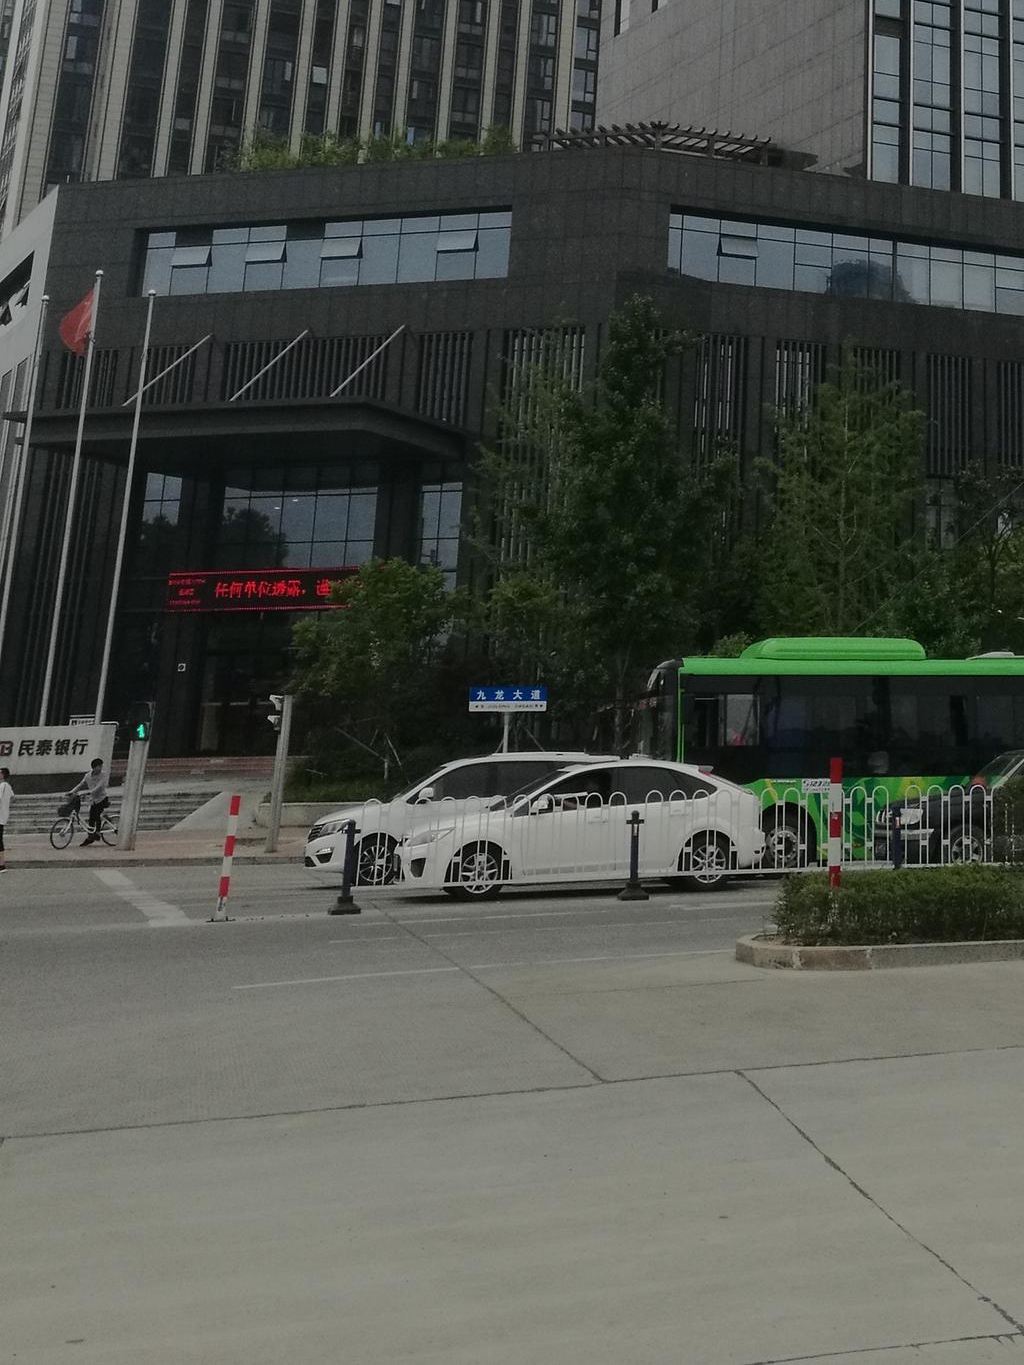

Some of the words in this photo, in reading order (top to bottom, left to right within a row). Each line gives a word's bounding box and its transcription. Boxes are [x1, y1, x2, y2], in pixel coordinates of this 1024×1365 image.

[476, 689, 542, 700] 九龙大道
[18, 739, 88, 756] 民泰银行
